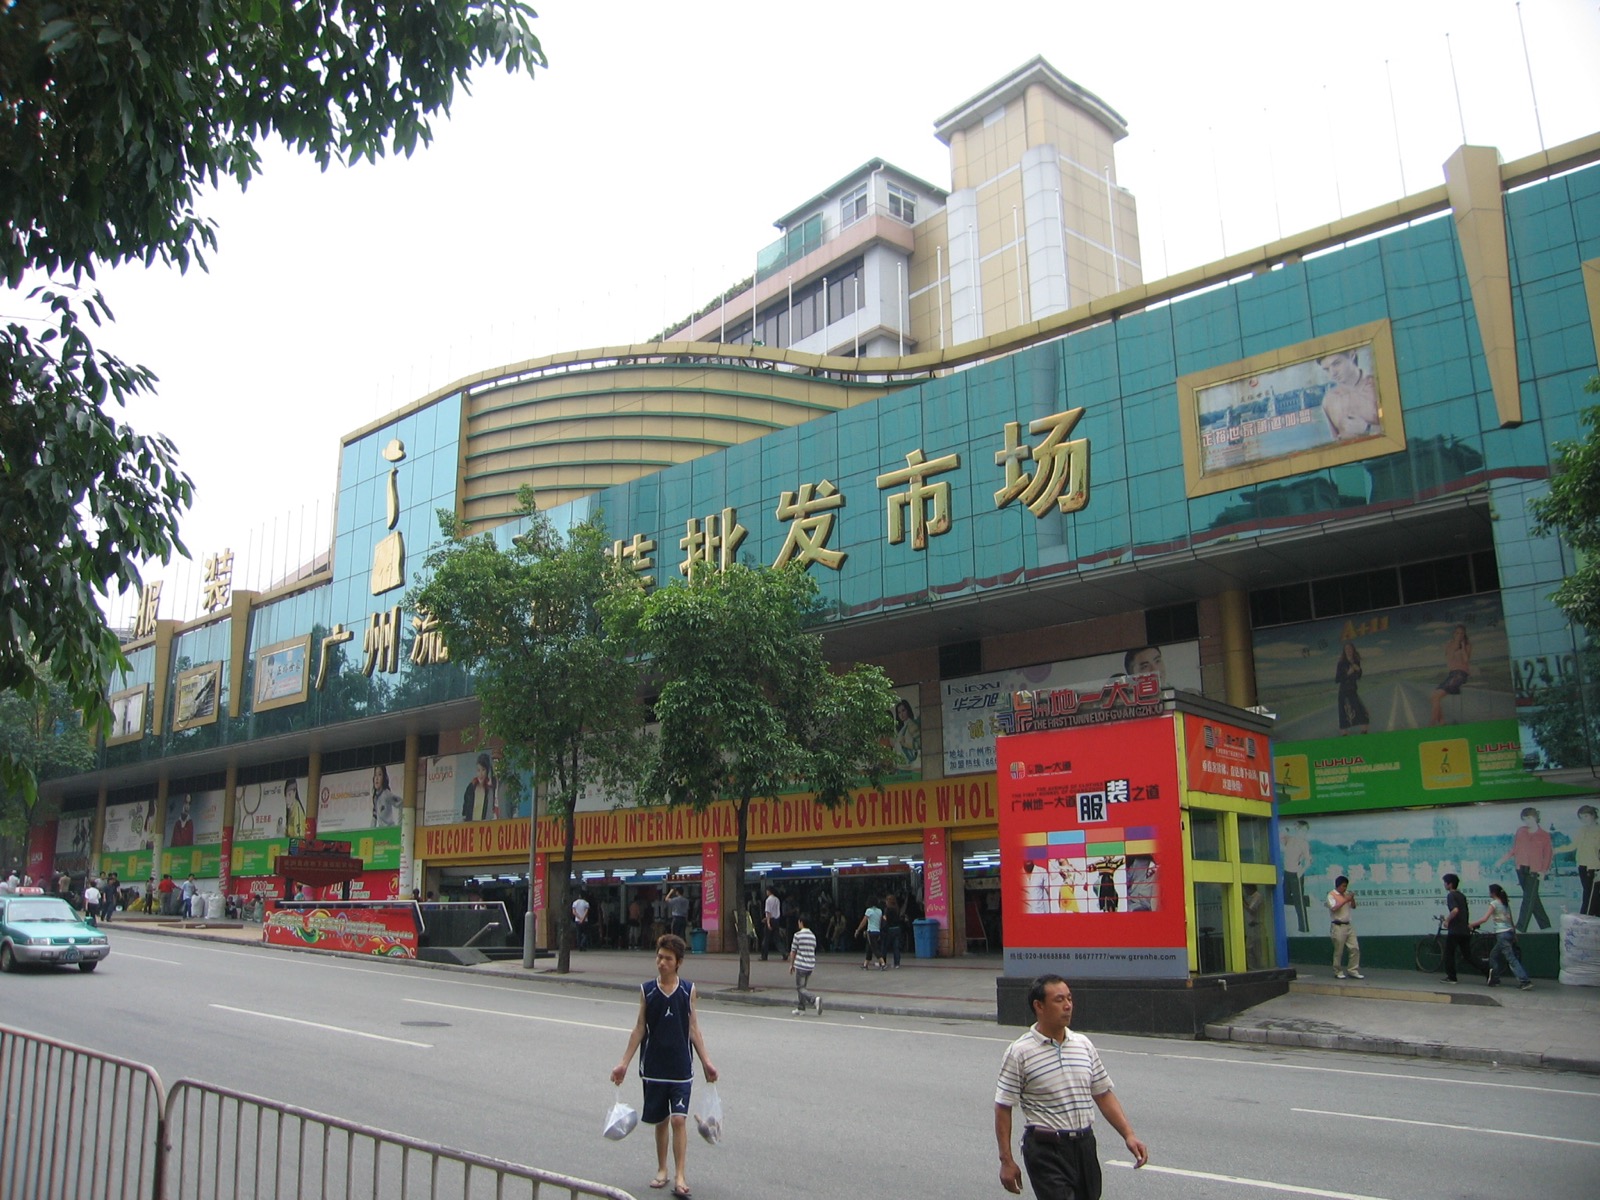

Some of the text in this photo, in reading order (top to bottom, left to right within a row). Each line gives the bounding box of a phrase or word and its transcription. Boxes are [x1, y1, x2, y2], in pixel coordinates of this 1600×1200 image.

[1314, 757, 1364, 768] LIUHUA
[426, 827, 474, 855] WELCOME
[480, 826, 492, 852] TO
[574, 815, 618, 846] LIUHUA
[749, 799, 822, 835] TRADING
[832, 786, 926, 827] CLOTHING
[935, 781, 995, 822] WHOL
